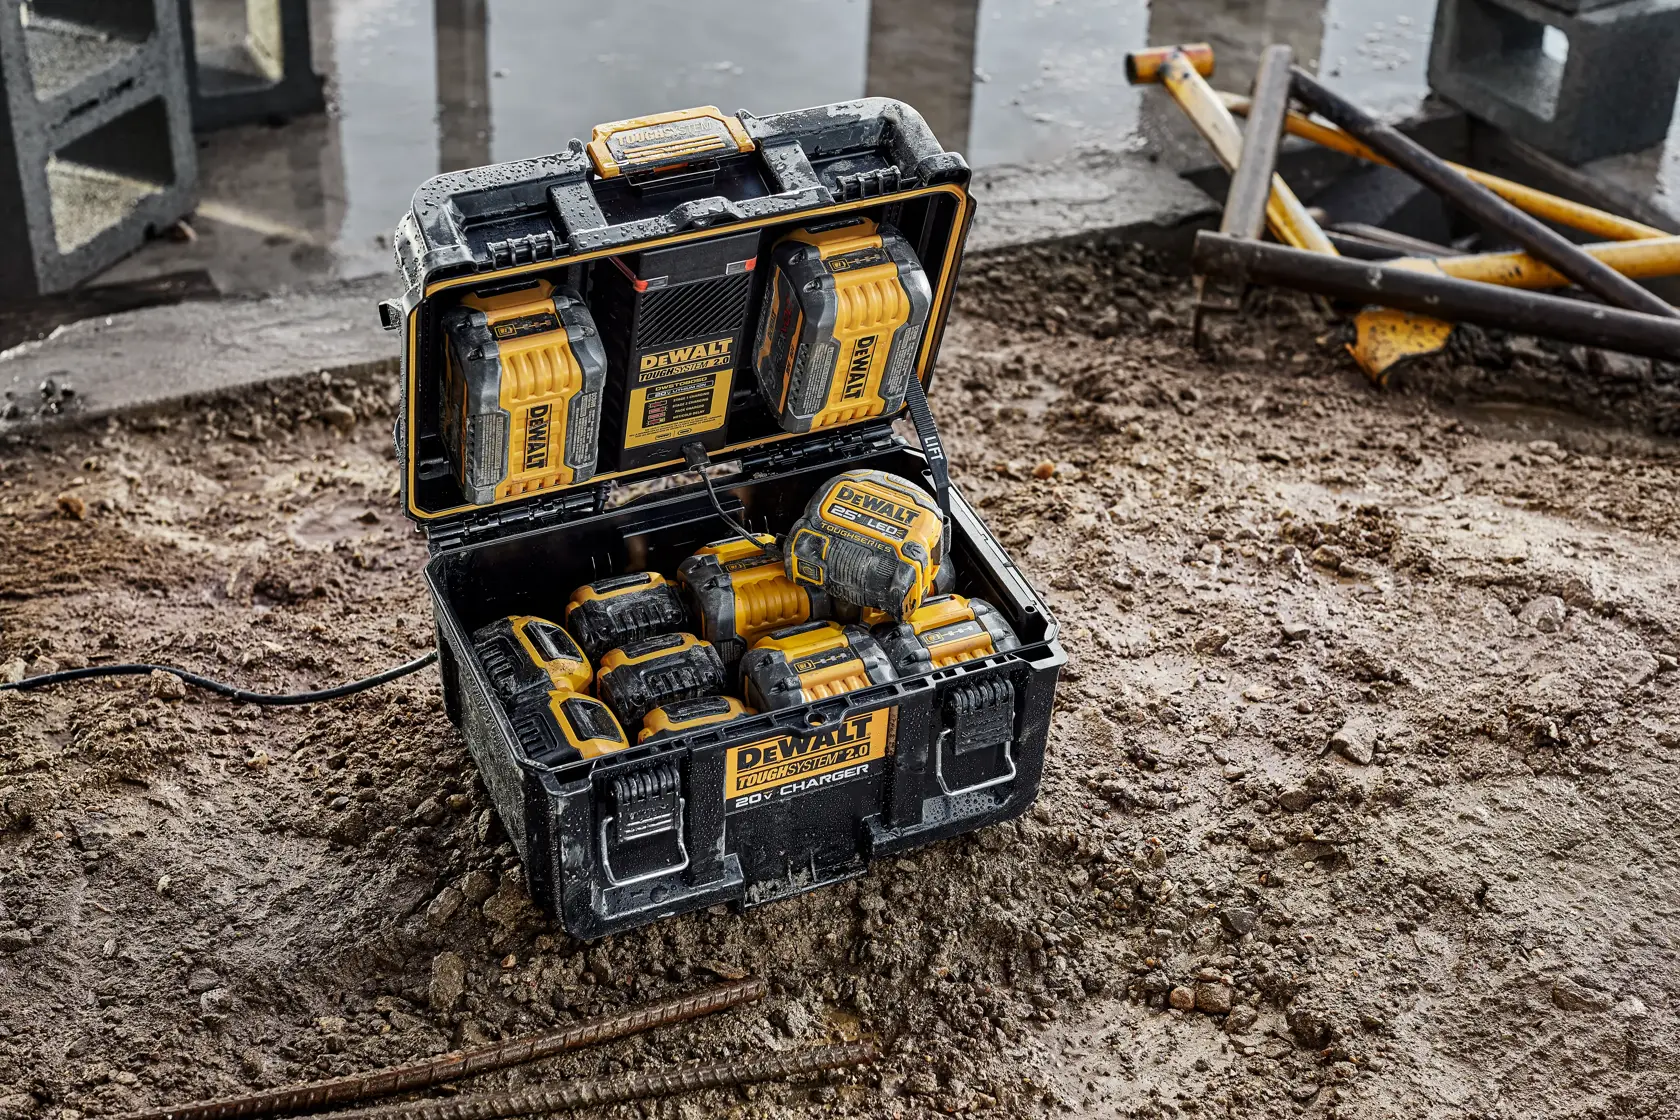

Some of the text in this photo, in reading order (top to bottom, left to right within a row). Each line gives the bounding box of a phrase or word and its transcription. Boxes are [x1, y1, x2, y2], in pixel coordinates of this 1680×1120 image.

[617, 121, 713, 146] TOUGHSYSTEM
[639, 356, 730, 381] TOUGHSYSTEM 2.0
[640, 338, 733, 371] DEWALT
[844, 335, 876, 400] DEWALT
[525, 404, 549, 469] DEWALT
[924, 436, 943, 460] LIFT
[836, 486, 920, 525] DEWALT
[821, 521, 892, 553] TOUGHSERIES
[867, 519, 898, 535] LED
[737, 717, 873, 771] DEWALT
[845, 744, 869, 760] 2.0
[779, 764, 869, 796] CHARGER
